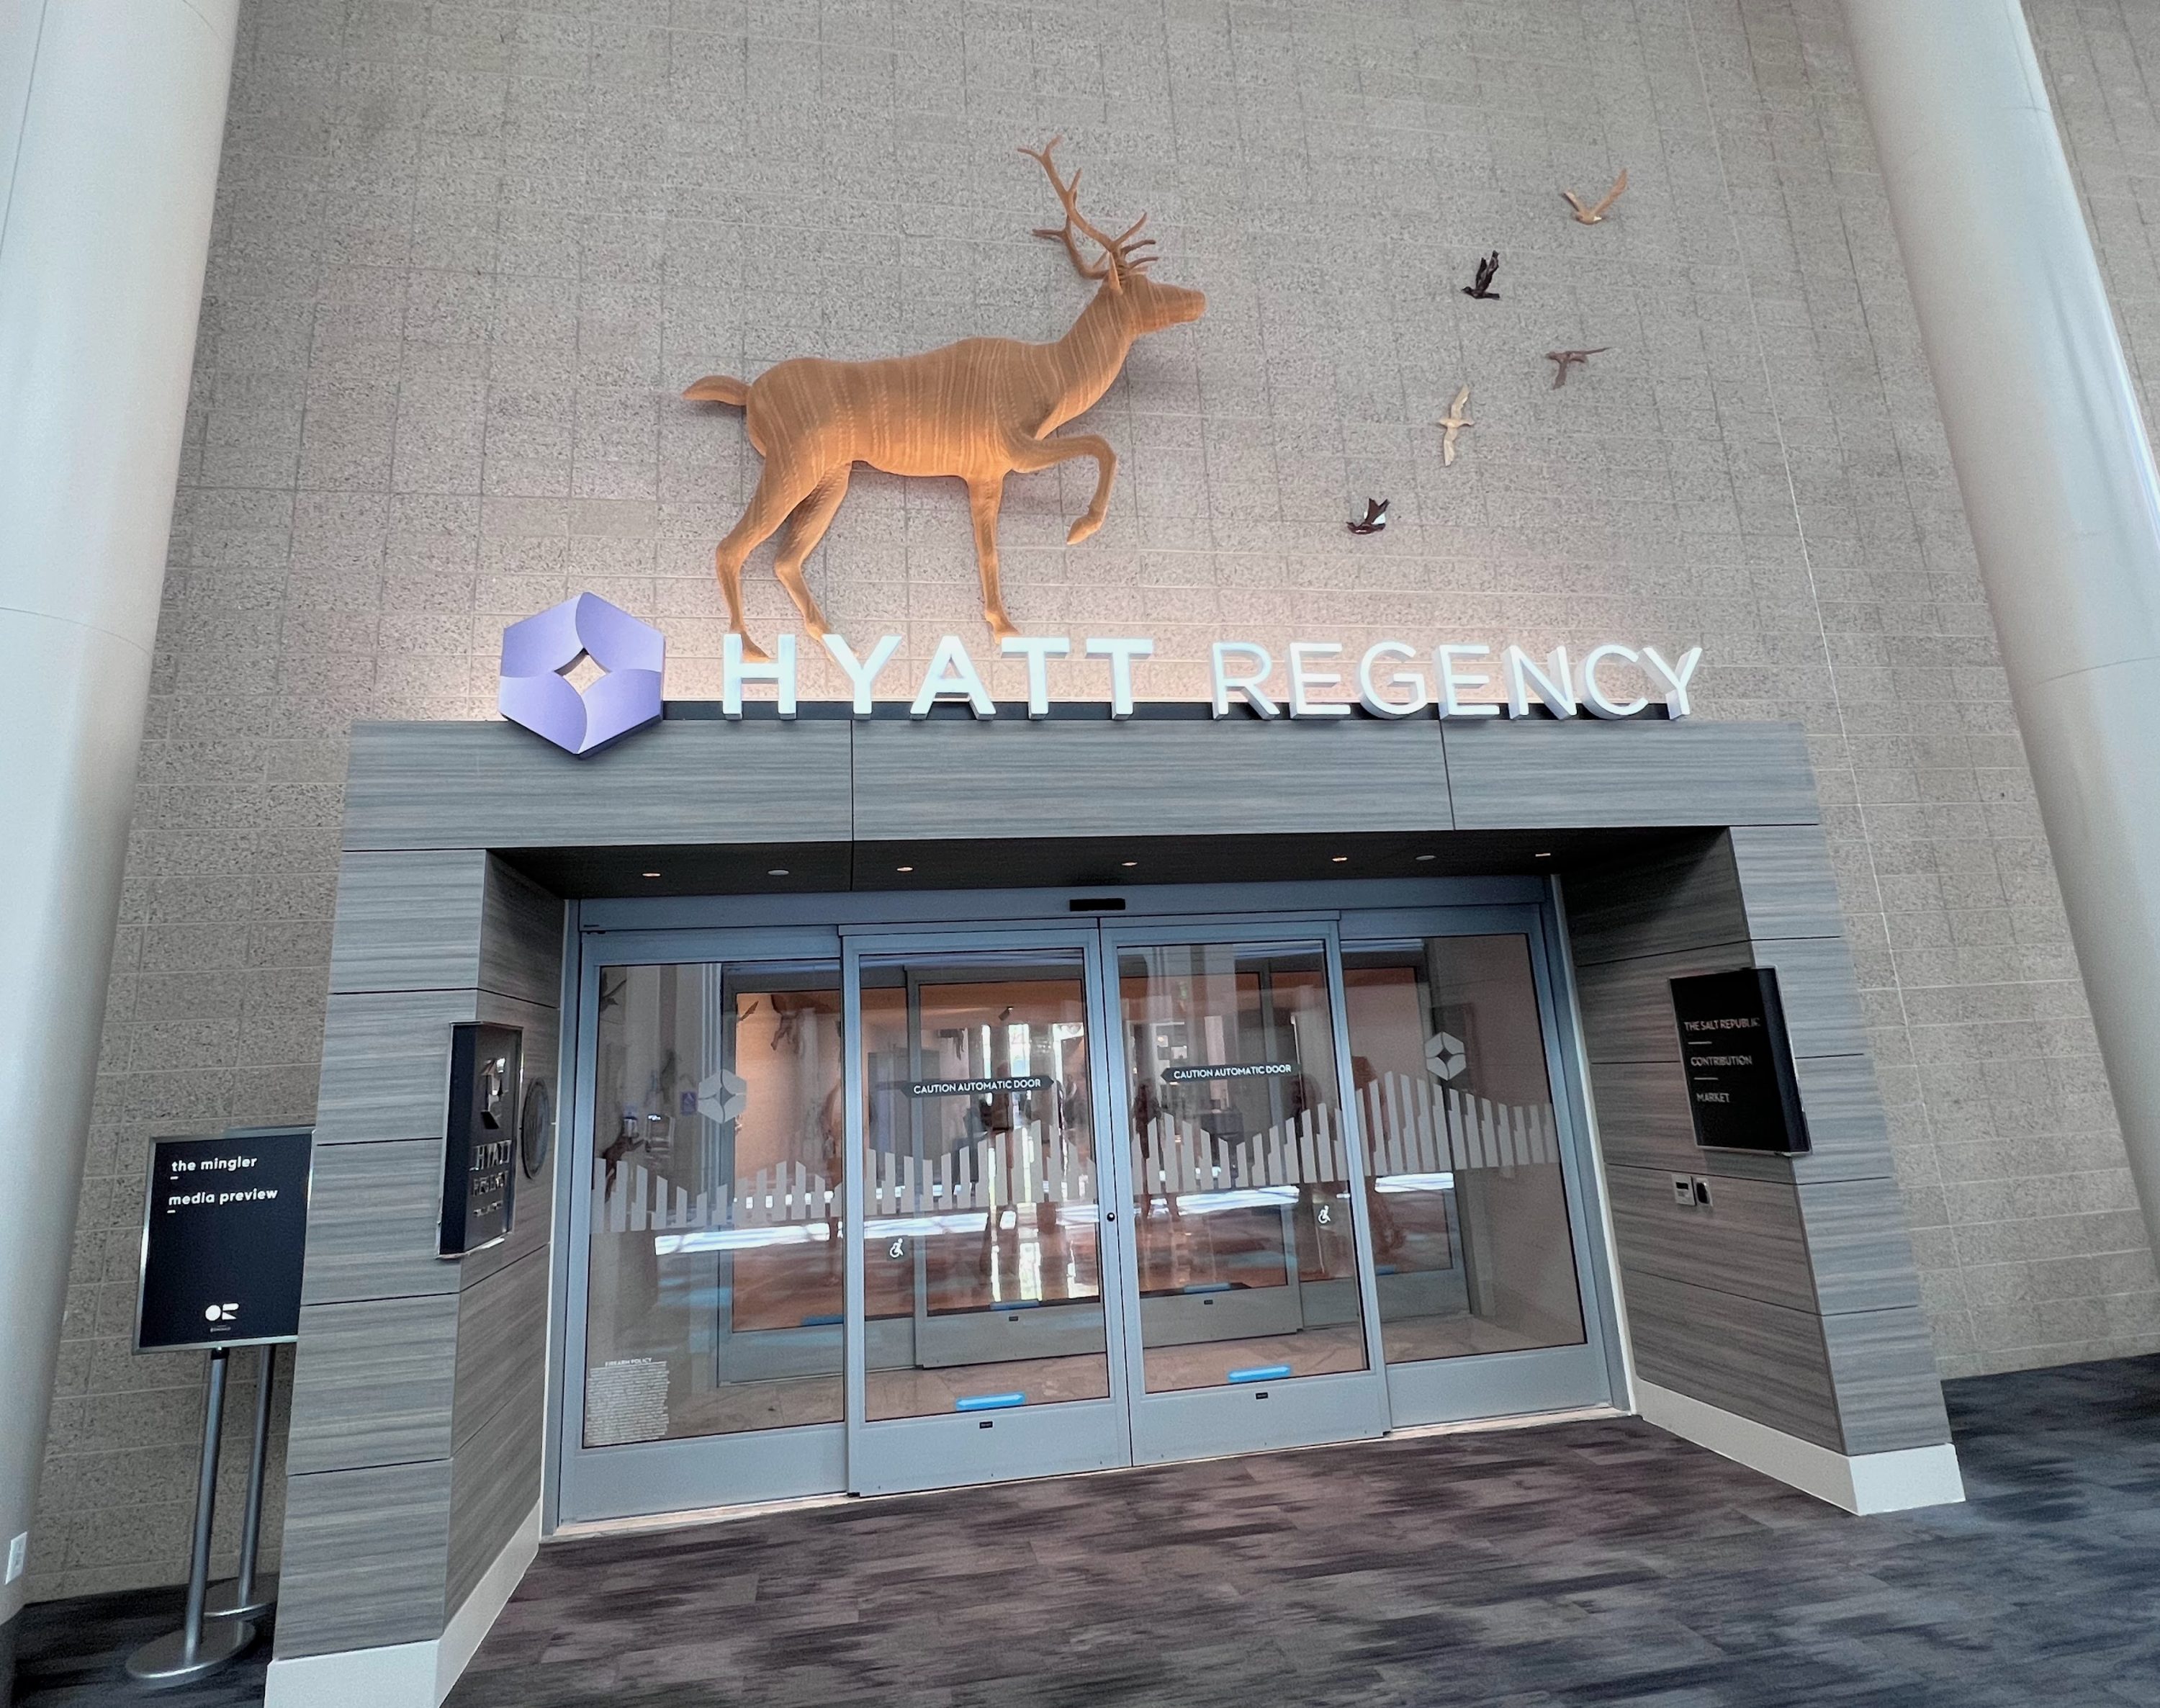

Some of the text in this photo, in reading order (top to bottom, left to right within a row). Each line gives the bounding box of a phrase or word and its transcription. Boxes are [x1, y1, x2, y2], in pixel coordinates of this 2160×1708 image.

[722, 633, 1704, 720] HYATT REGENCY
[1683, 1017, 1761, 1032] THE SALT REPUBLIC
[1690, 1055, 1753, 1066] CONTRIBUTION
[1174, 1064, 1292, 1079] CAUTION AUTOMATIC DOOR
[913, 1079, 1041, 1095] CAUTION AUTOMATIC DOOR
[1696, 1092, 1730, 1103] MARKET
[171, 1155, 258, 1172] the mingler
[168, 1188, 279, 1205] media preview
